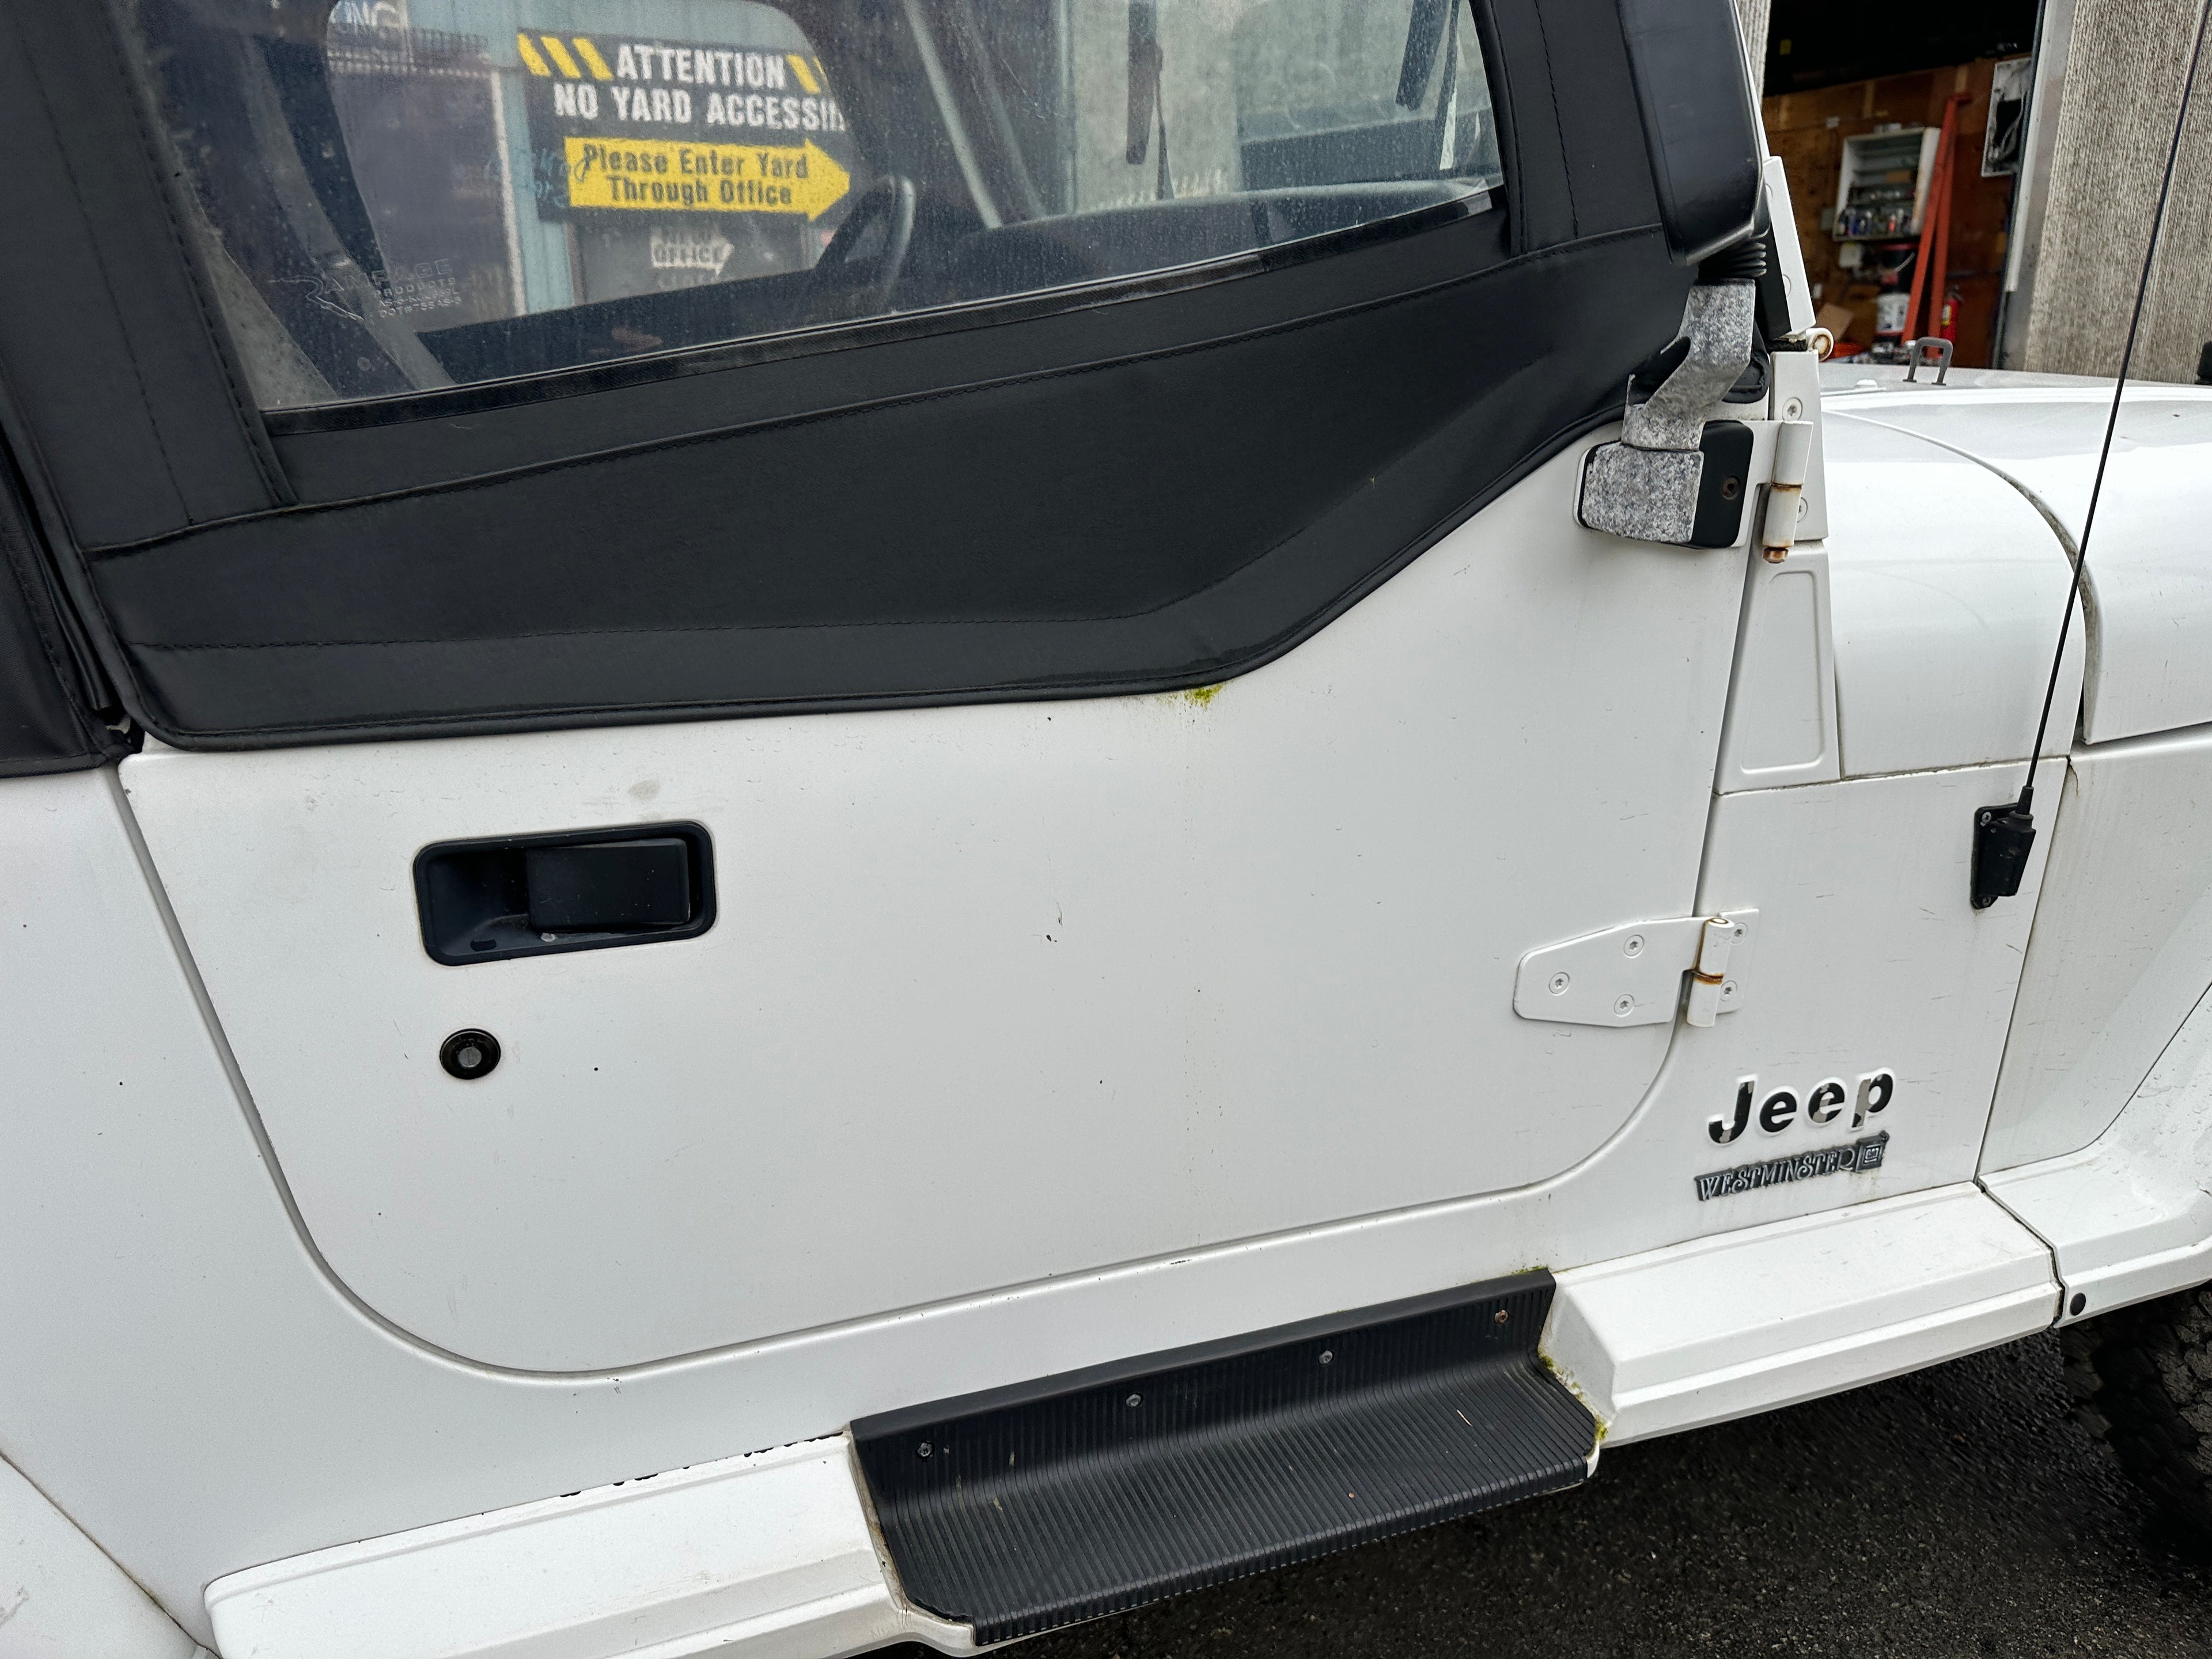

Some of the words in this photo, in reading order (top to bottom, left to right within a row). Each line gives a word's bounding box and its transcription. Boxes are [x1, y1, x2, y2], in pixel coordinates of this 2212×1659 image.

[616, 43, 787, 89] ATTENTION
[553, 82, 599, 120] NO
[610, 86, 692, 123] YARD
[581, 143, 668, 175] Please
[680, 149, 745, 176] Enter
[756, 152, 809, 179] Yard
[608, 175, 708, 205] Through
[720, 179, 792, 204] Office
[1707, 1070, 1895, 1146] Jeep
[1698, 1145, 1854, 1201] WESTMINSTER
